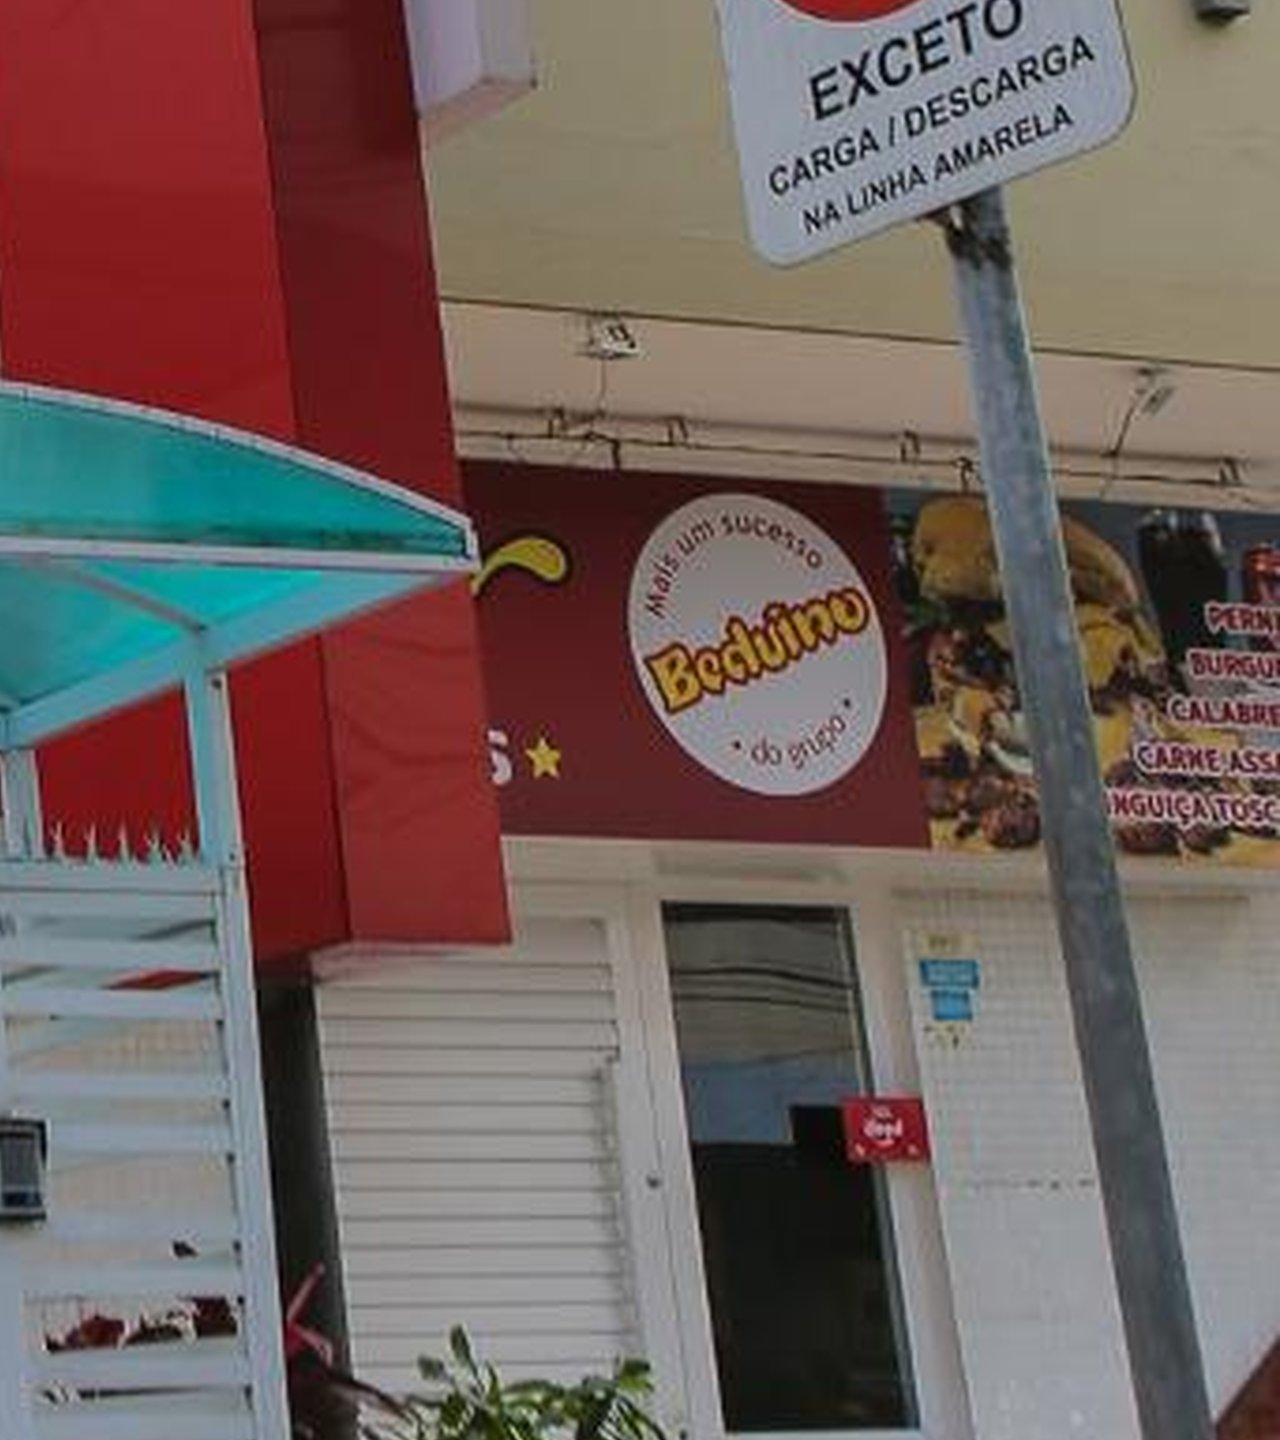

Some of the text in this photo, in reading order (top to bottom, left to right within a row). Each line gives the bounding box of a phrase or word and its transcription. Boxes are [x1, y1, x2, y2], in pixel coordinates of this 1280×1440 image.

[768, 128, 880, 197] CARGA
[903, 34, 1095, 138] DESCARGA
[802, 104, 1075, 235] NA LINHA AMARELA
[644, 514, 823, 619] Mais um sucesso
[1204, 601, 1280, 635] PERN
[1188, 648, 1280, 680] BURGU
[1135, 740, 1280, 780] CARNE ASS
[1214, 794, 1280, 830] TOSC
